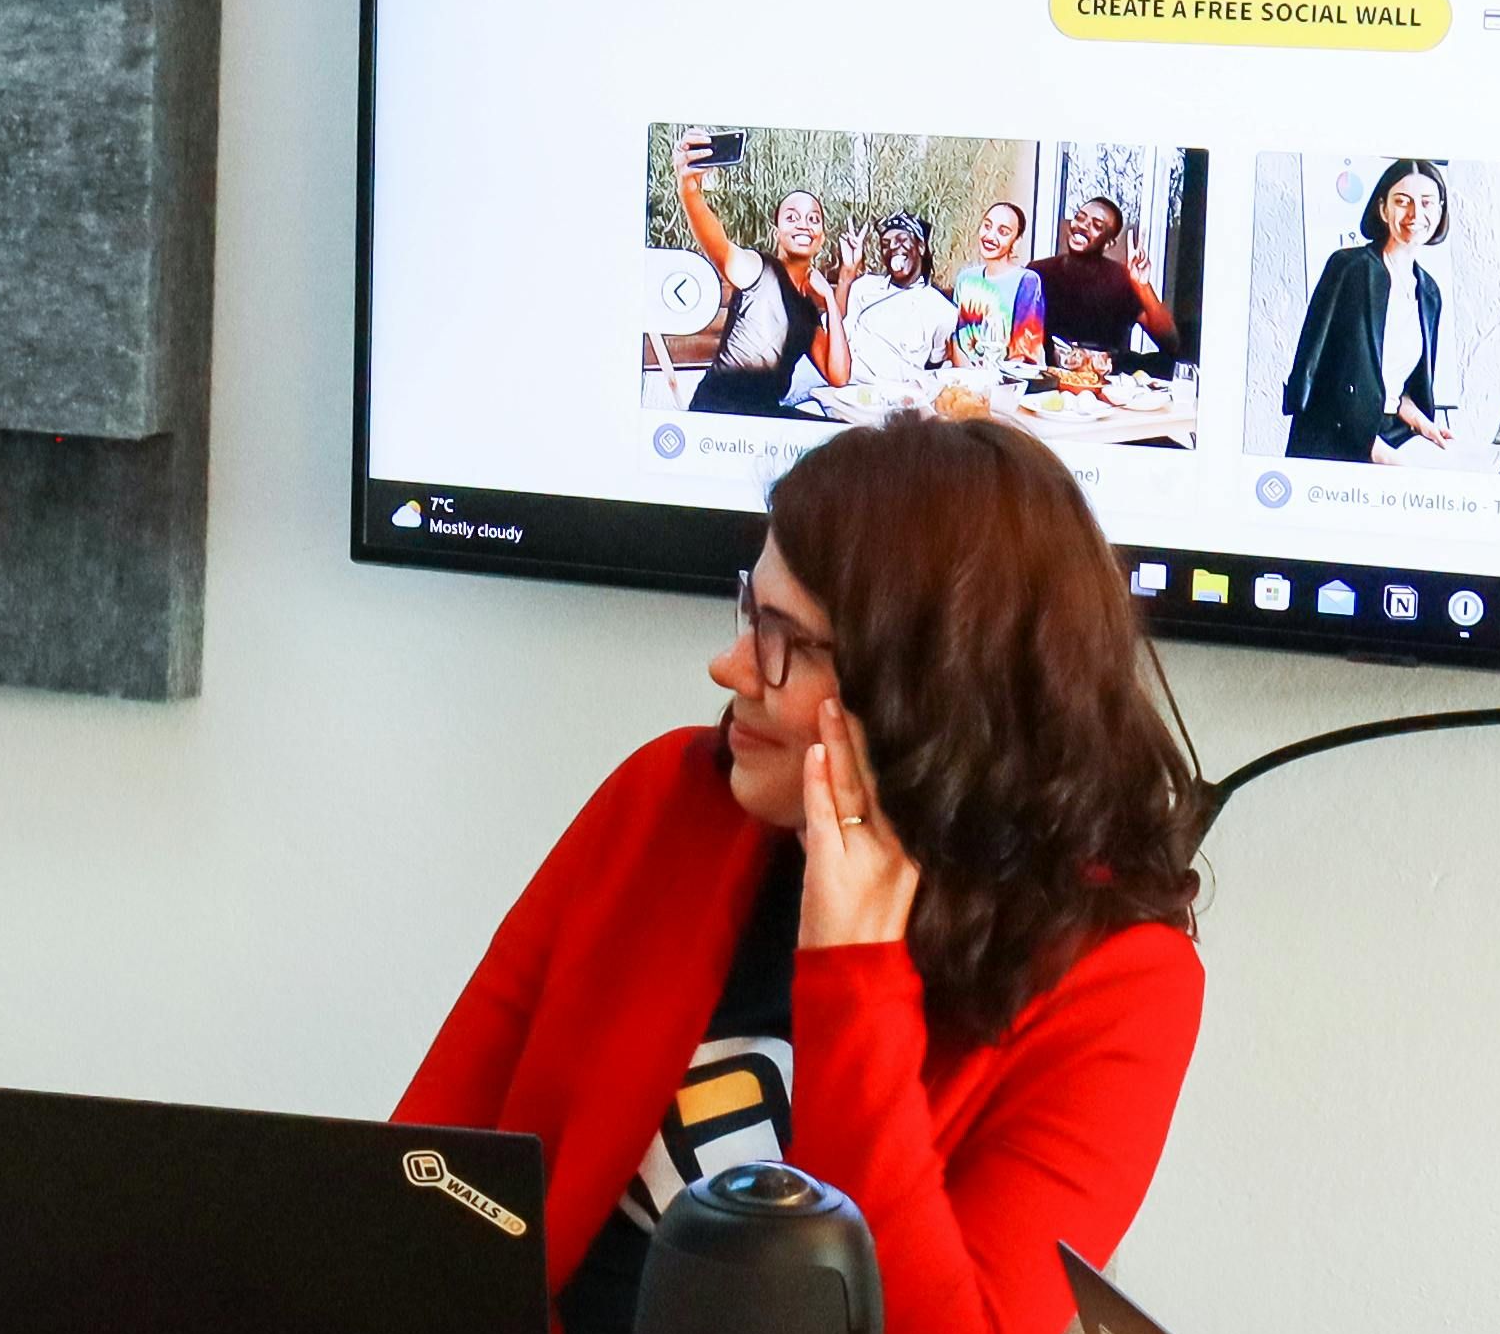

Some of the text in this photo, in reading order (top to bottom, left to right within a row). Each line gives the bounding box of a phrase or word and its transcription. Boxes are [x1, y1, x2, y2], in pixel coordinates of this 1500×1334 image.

[1171, 0, 1188, 20] A
[1194, 0, 1253, 22] FREE
[1261, 2, 1348, 25] SOCIAL
[1355, 5, 1422, 28] WALL
[699, 437, 779, 459] @walls_io
[429, 496, 455, 513] 7°C
[1307, 484, 1397, 509] @walls_io
[1403, 489, 1478, 515] (Walls.io
[429, 519, 524, 544] Mostly cloudy
